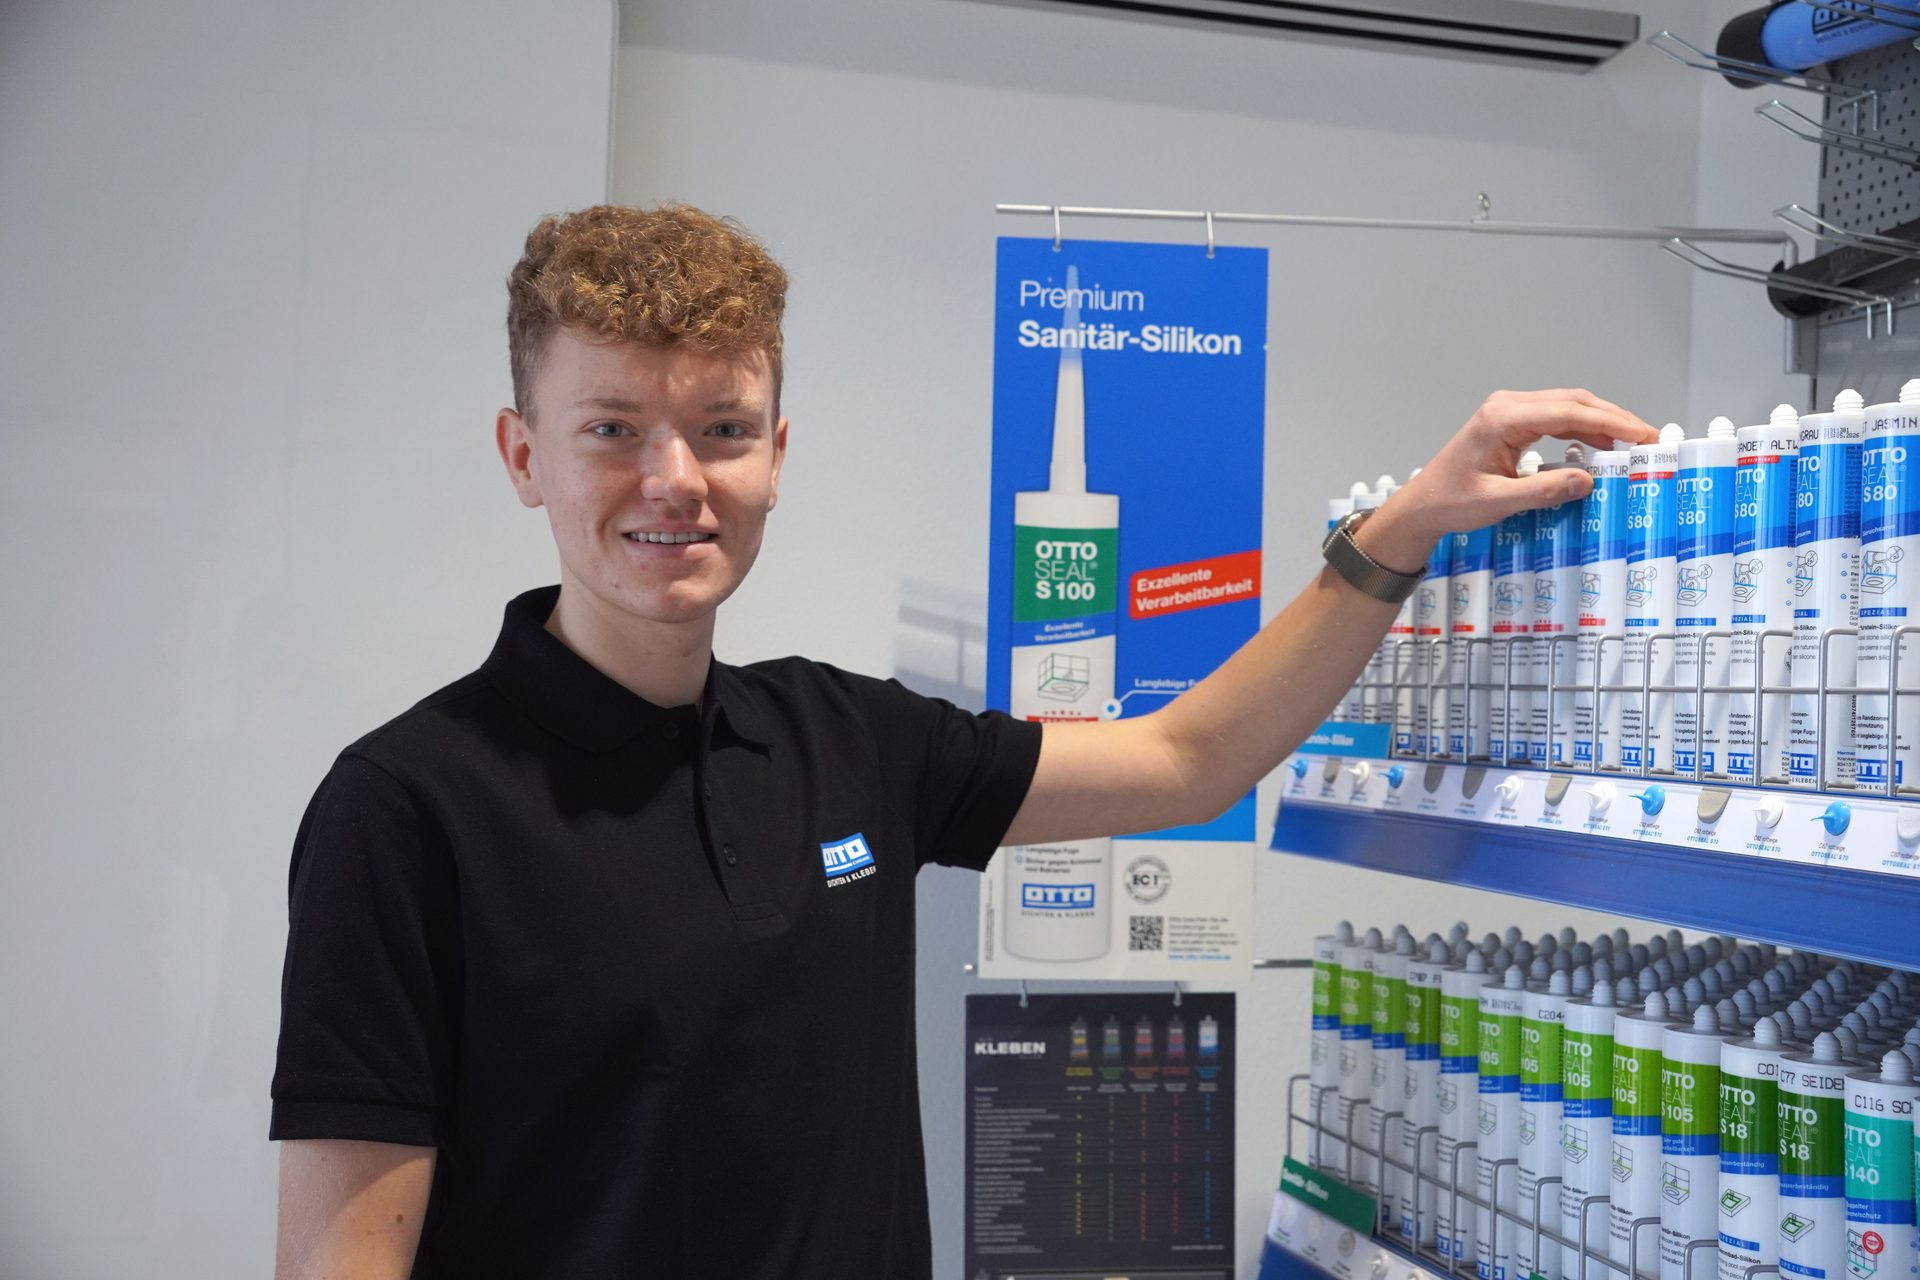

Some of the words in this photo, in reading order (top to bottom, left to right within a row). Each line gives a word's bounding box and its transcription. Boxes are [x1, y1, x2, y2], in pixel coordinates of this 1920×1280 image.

[1019, 279, 1145, 312] Premium
[1018, 320, 1242, 356] Sanitär-Silikon
[1872, 417, 1918, 431] JASMIN
[1797, 456, 1820, 473] TTO
[1035, 540, 1098, 561] OTTO
[1137, 569, 1212, 592] Exzellente
[1135, 578, 1253, 612] Verarbeitbarkeit
[1024, 886, 1093, 903] OTTO
[974, 1041, 1046, 1055] KLEBEN
[1854, 1094, 1884, 1112] C116
